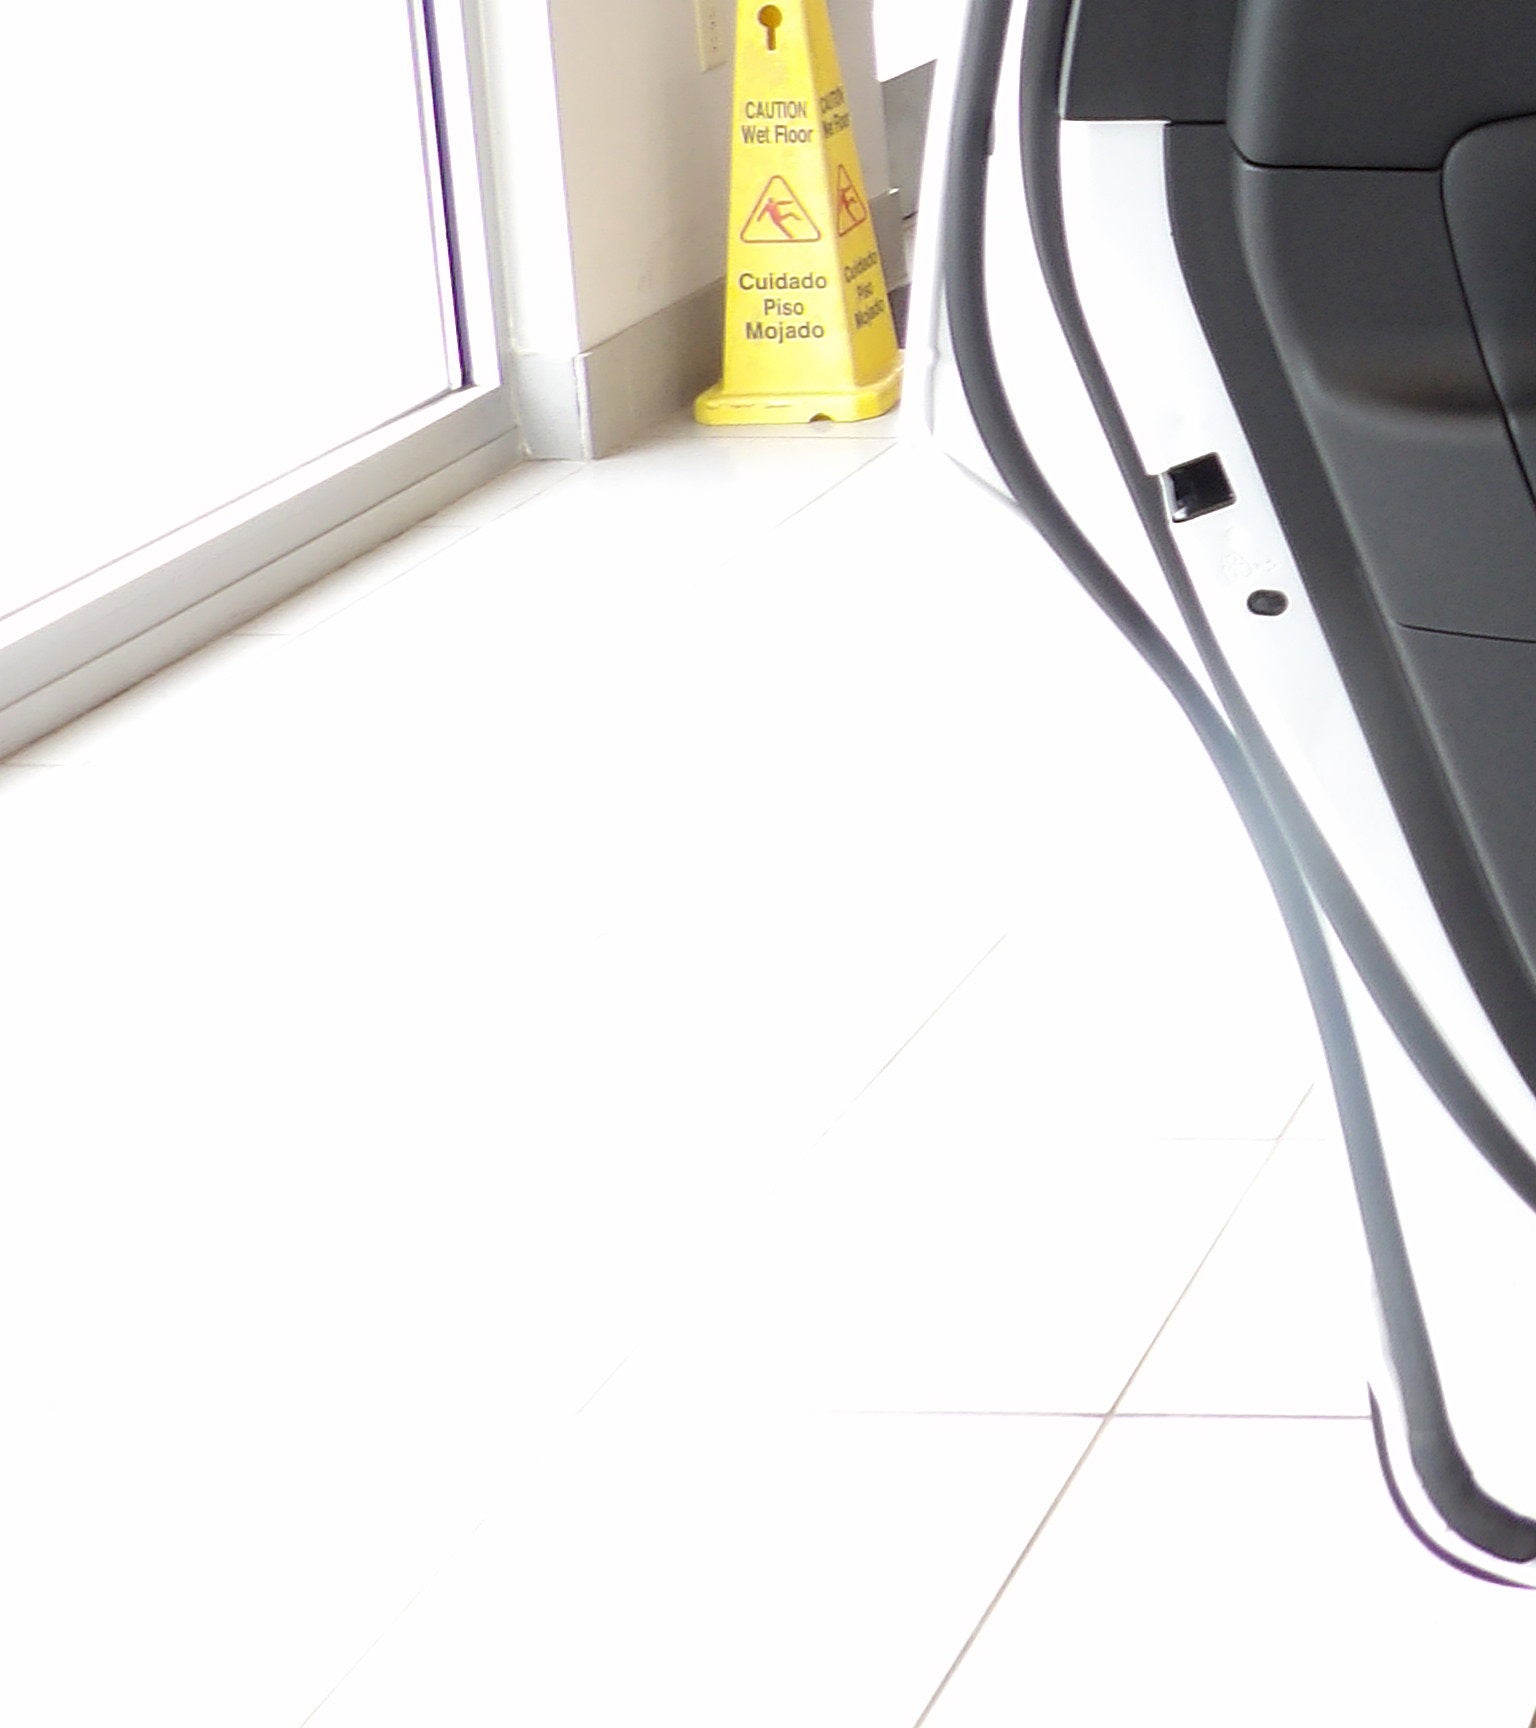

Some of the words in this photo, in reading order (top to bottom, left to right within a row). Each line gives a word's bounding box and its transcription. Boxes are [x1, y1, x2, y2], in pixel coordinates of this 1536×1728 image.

[745, 101, 807, 119] CAUTION
[741, 125, 770, 143] Wet
[775, 125, 813, 143] Floor
[739, 272, 827, 290] Cuidado
[763, 298, 804, 316] Piso
[745, 321, 824, 344] Mojado
